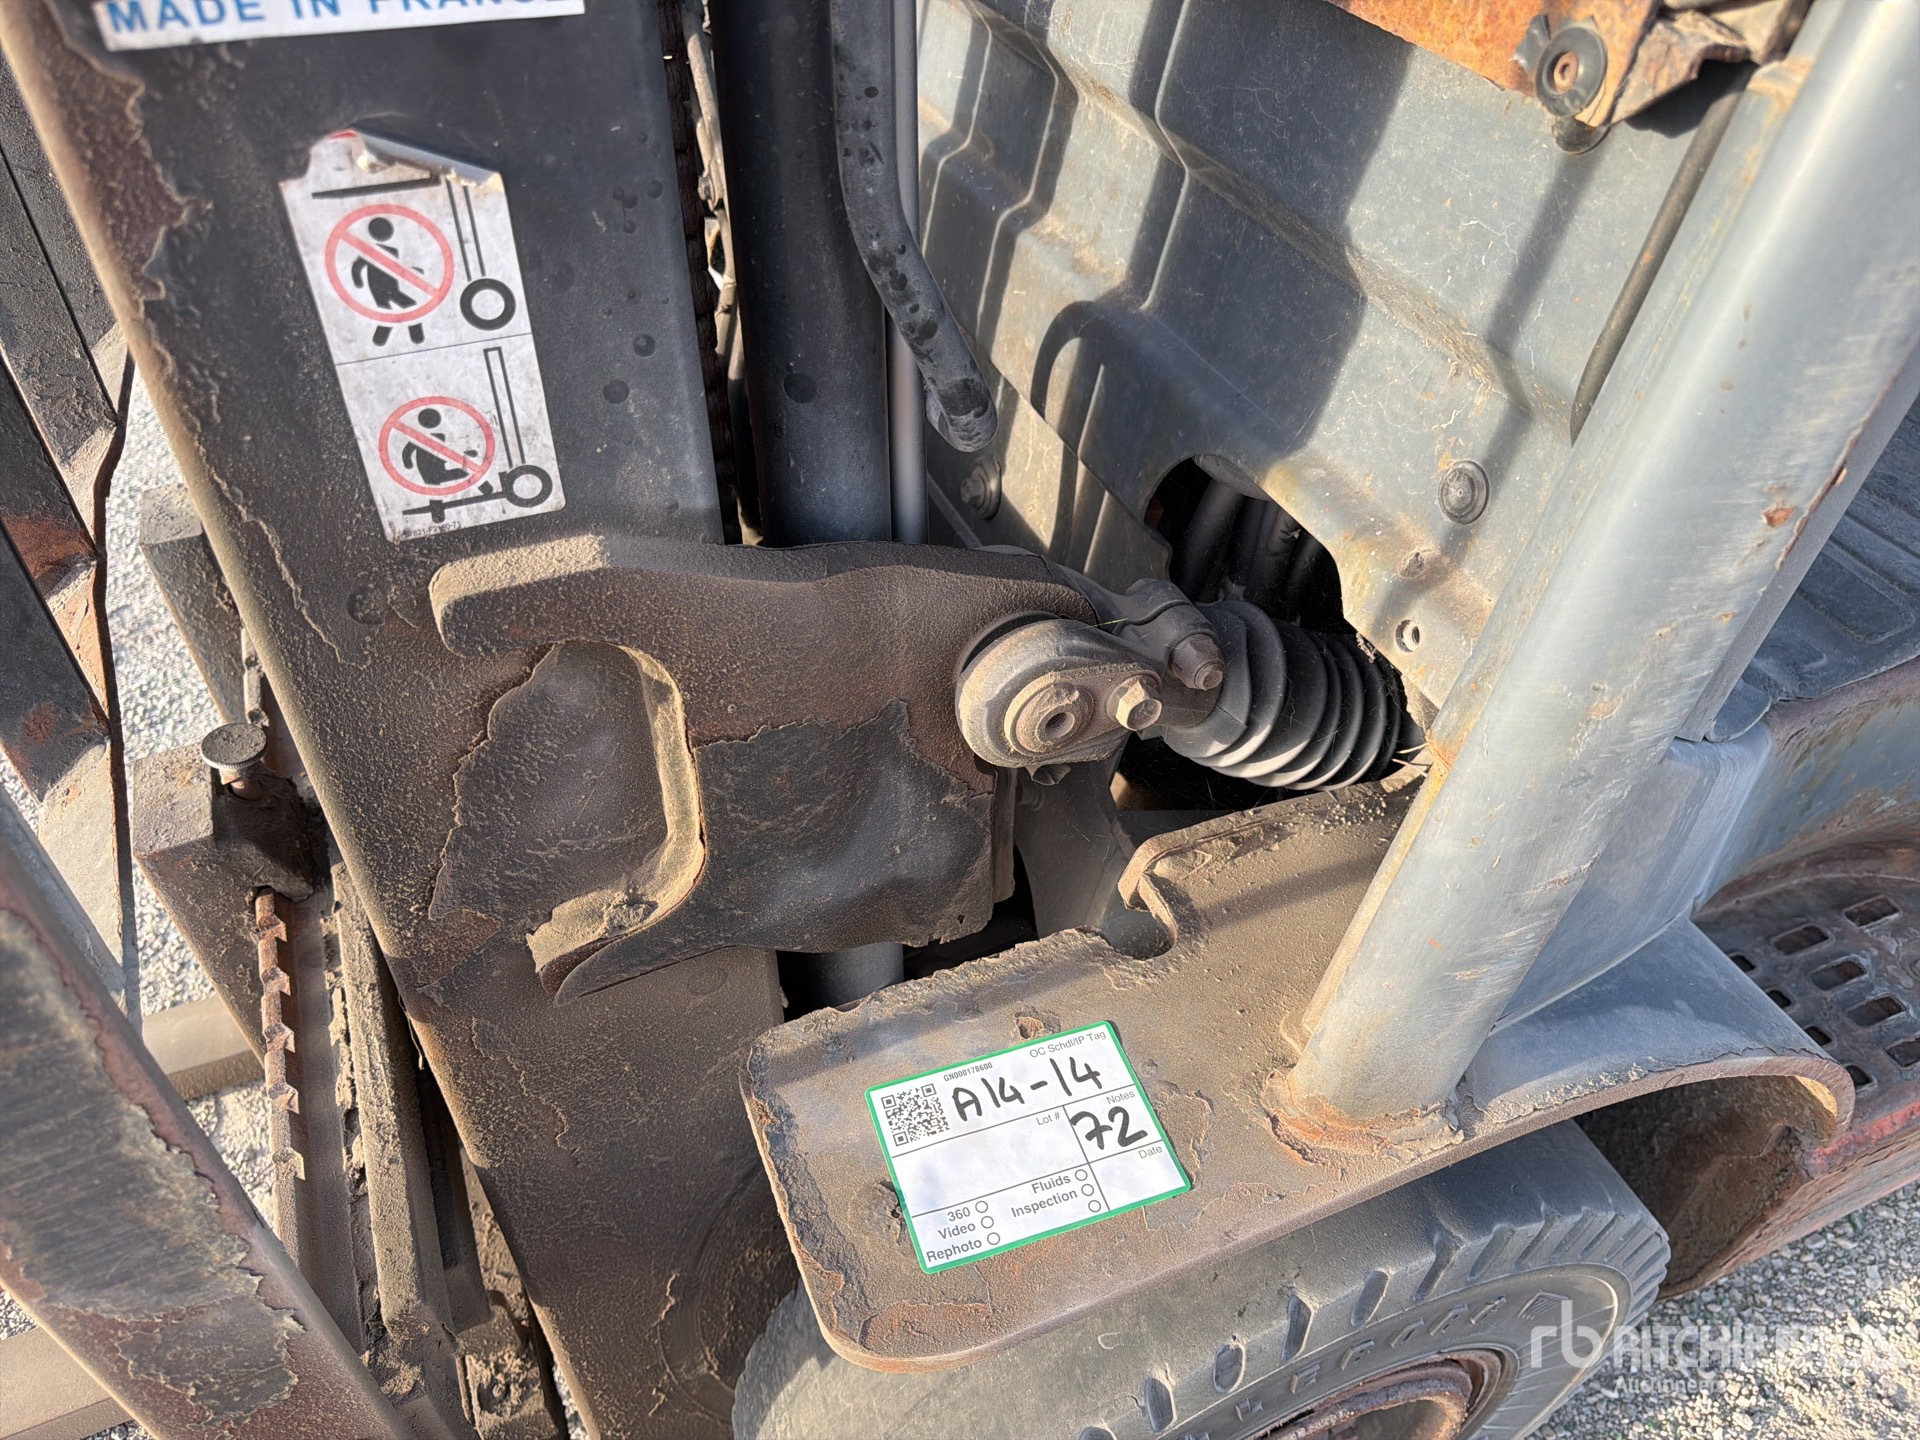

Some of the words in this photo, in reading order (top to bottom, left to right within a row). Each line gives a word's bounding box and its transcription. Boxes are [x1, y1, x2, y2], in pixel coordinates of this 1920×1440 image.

[106, 0, 266, 32] MADE
[289, 0, 341, 19] IN
[1029, 1046, 1046, 1058] OC
[1086, 1031, 1107, 1042] Tag
[943, 1062, 993, 1082] GN000178600
[1106, 1091, 1136, 1105] Notes
[1036, 1113, 1053, 1126] Lot
[1054, 1111, 1061, 1121] #
[1068, 1105, 1149, 1151] 72
[1138, 1145, 1164, 1160] Date
[1031, 1174, 1072, 1195] Fluids
[1011, 1189, 1079, 1218] Inspection
[947, 1206, 971, 1223] 360
[938, 1222, 977, 1240] Video
[926, 1239, 983, 1263] Rephoto
